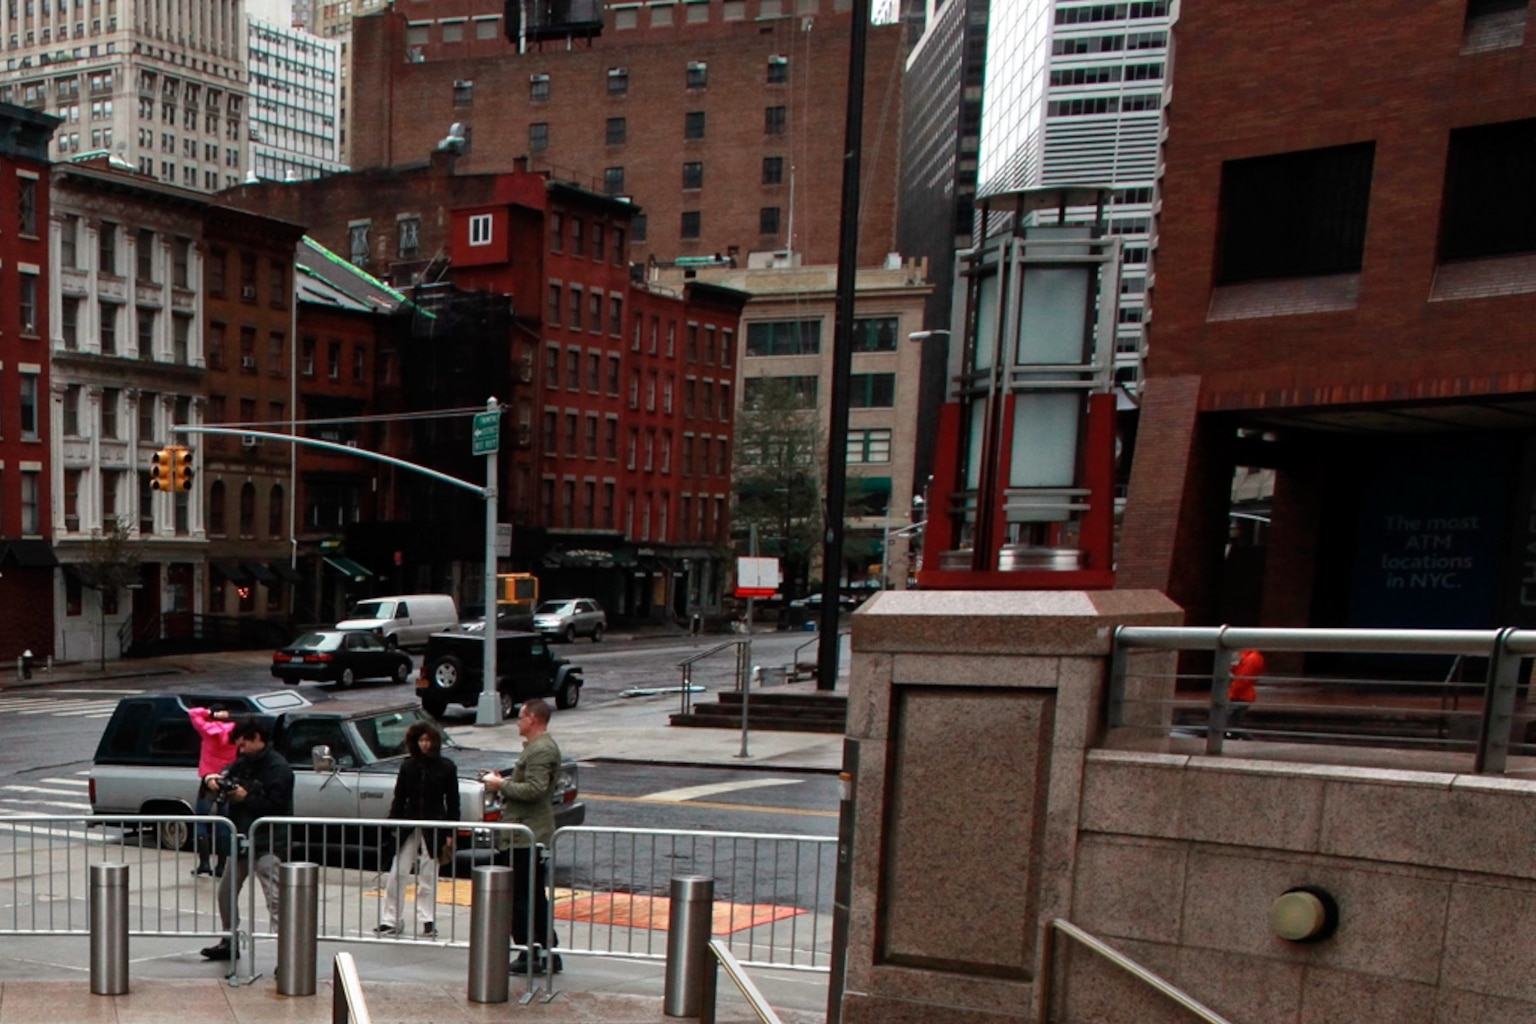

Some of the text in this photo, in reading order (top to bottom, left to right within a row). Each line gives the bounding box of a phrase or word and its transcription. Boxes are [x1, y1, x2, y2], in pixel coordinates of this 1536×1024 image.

[1384, 514, 1481, 531] The most
[1405, 534, 1453, 551] ATM
[1381, 553, 1473, 570] locations
[1386, 571, 1462, 589] in NYC.
